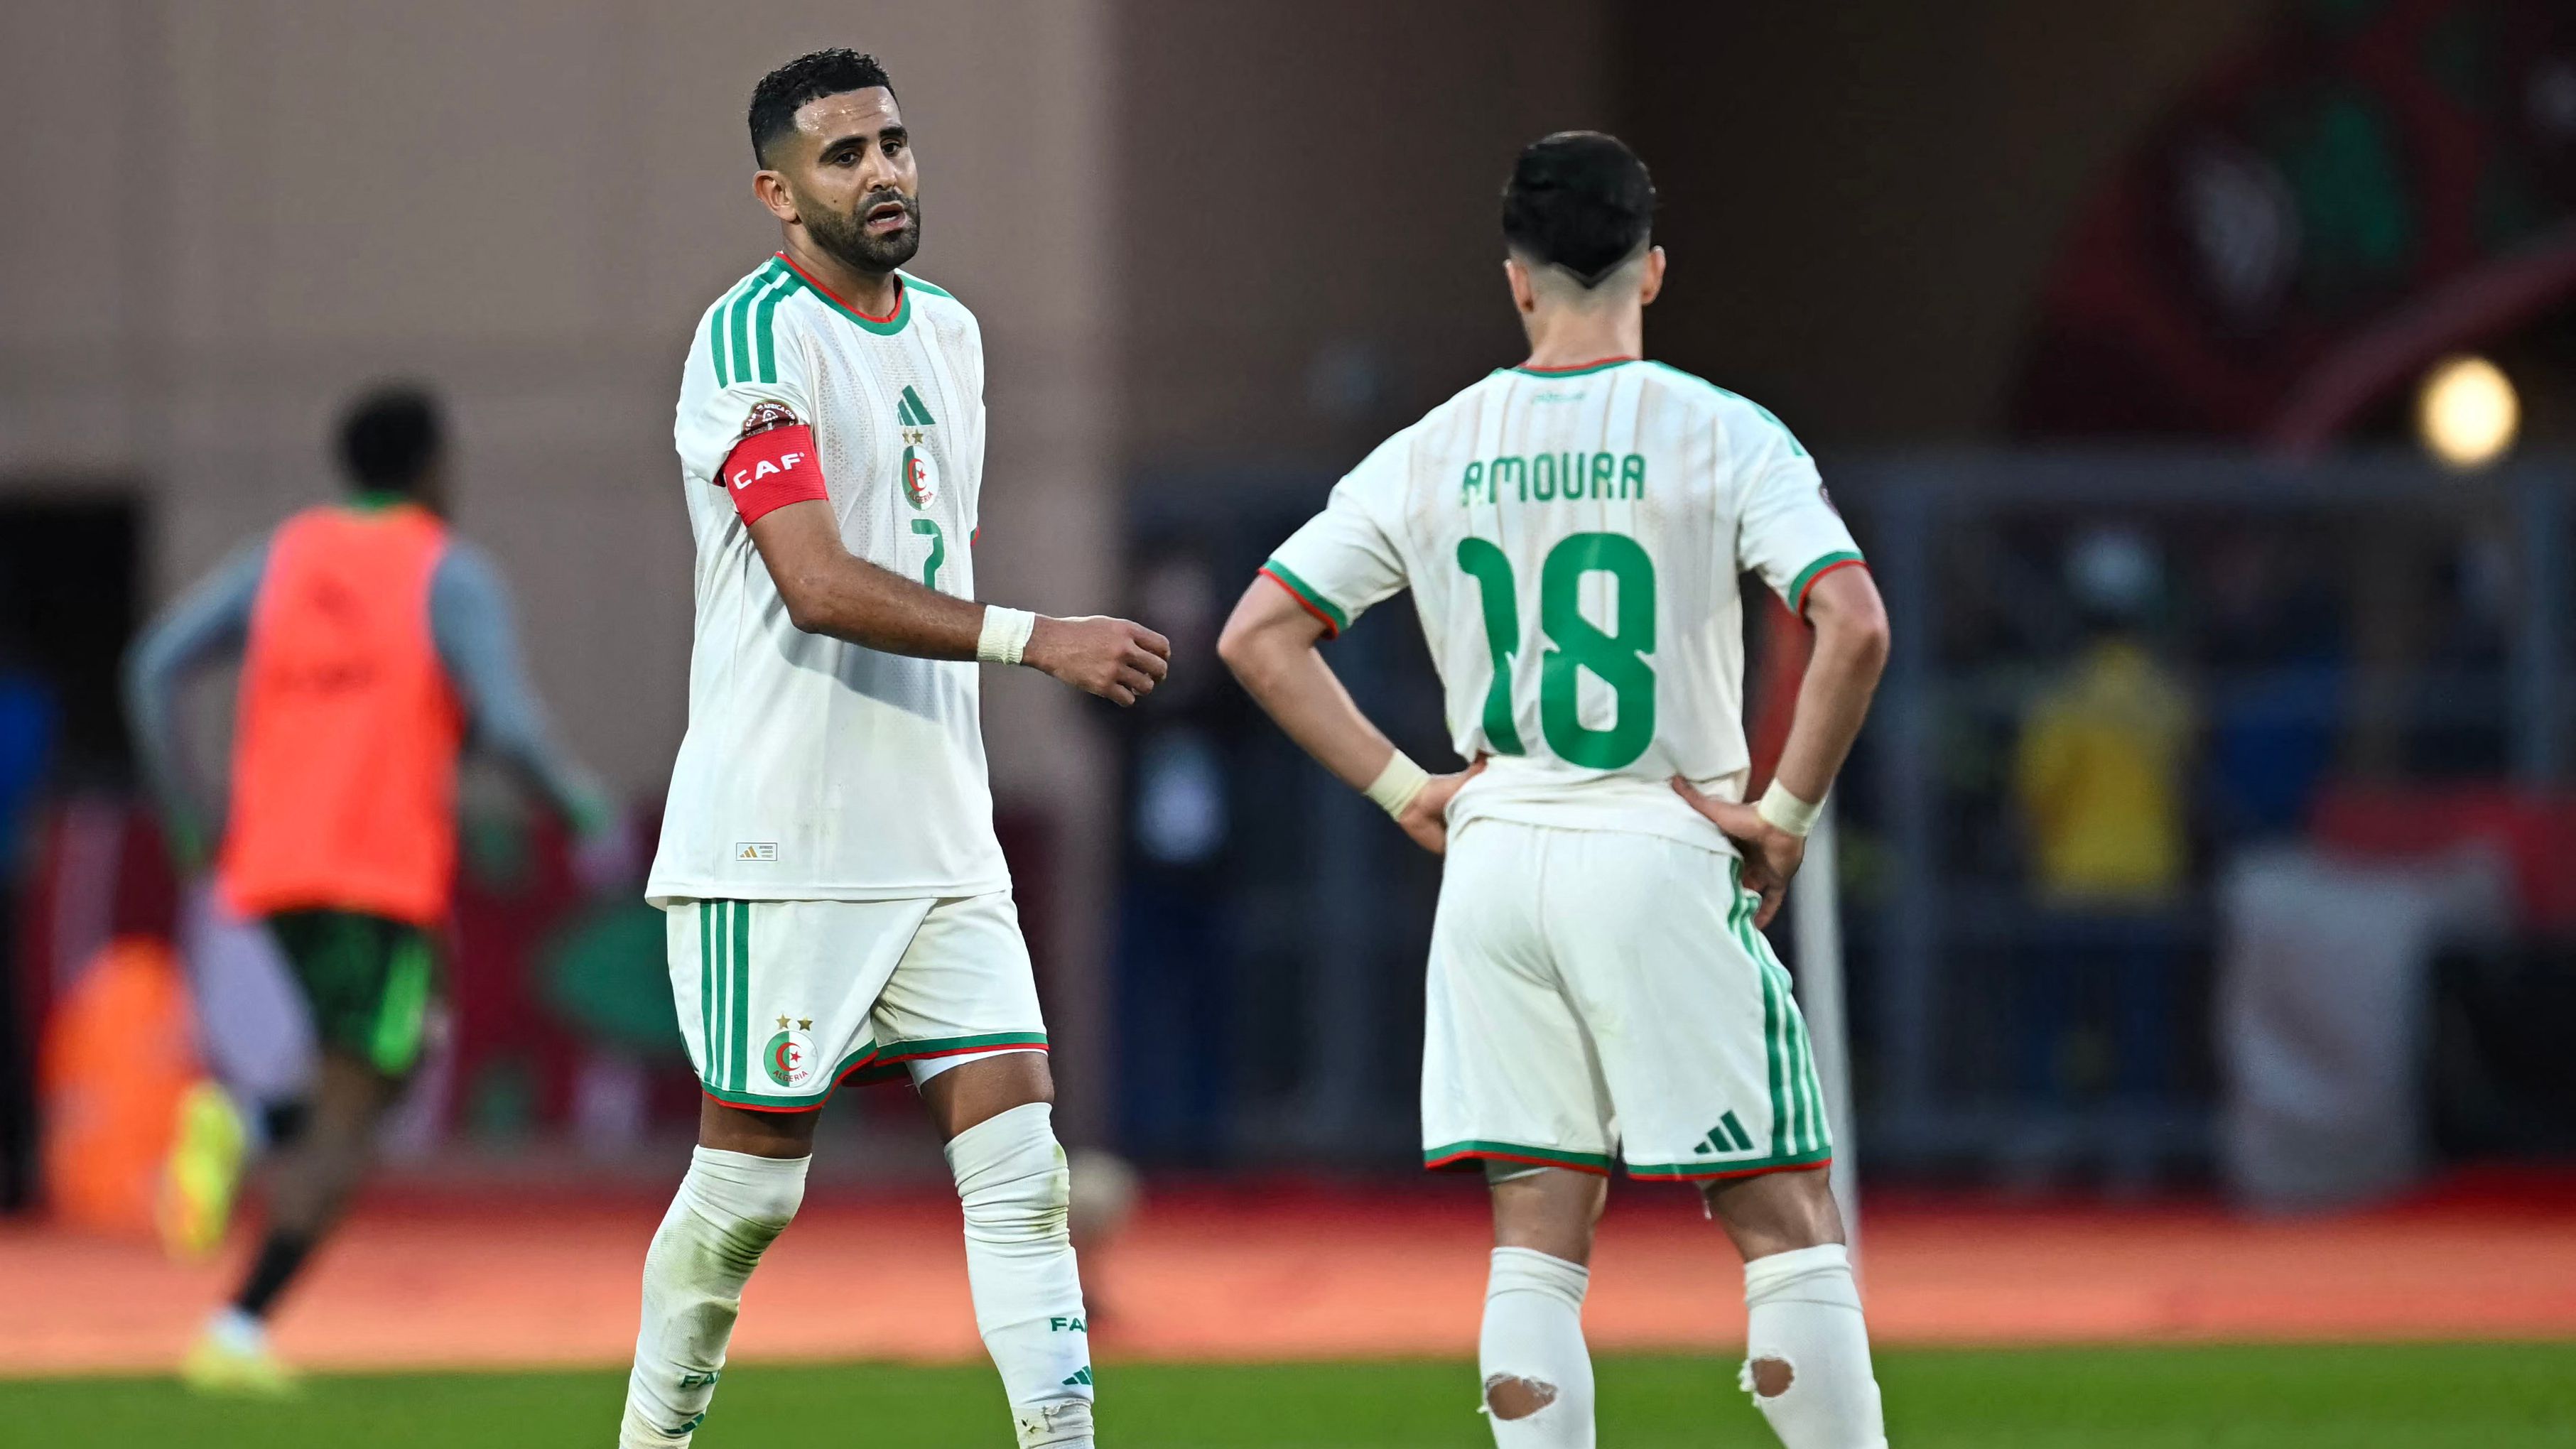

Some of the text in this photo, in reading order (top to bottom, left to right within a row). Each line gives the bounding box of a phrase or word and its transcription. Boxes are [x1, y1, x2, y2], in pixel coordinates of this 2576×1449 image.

[732, 452, 801, 490] CAF
[1461, 452, 1646, 506] AMOURA
[909, 490, 933, 504] ALGERIA
[911, 519, 945, 592] 7
[1456, 531, 1657, 770] 18
[772, 1069, 809, 1082] ALGERIA
[1050, 1316, 1088, 1333] FA
[679, 1369, 721, 1388] FA
